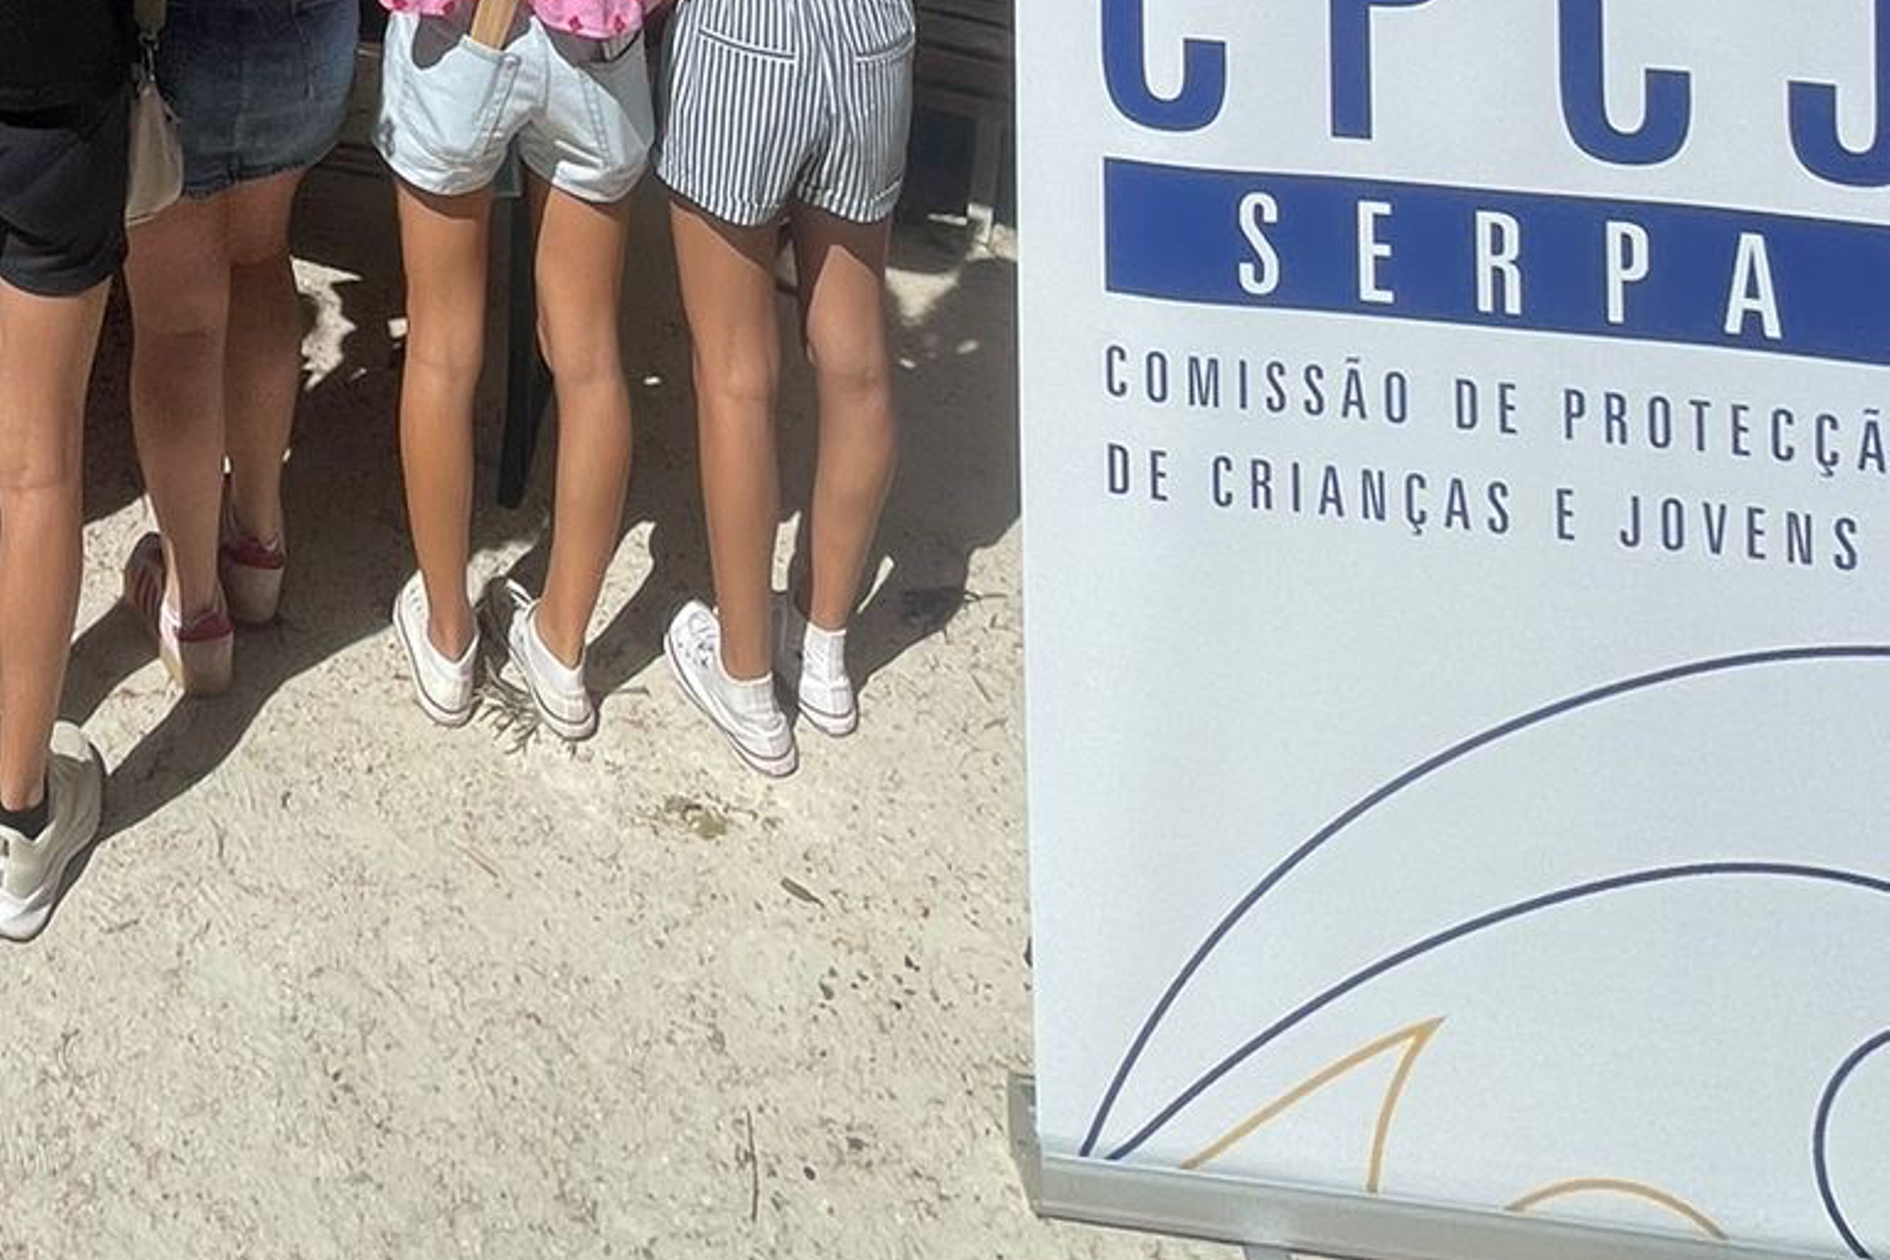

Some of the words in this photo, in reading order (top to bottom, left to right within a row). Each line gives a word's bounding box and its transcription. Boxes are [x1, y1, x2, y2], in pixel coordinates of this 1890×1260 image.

[1238, 192, 1783, 340] SERPA
[1105, 345, 1408, 424] COMISSÃO
[1455, 378, 1517, 435] DE
[1563, 388, 1887, 477] PROTECÇÃ
[1107, 442, 1168, 502] DE
[1212, 455, 1509, 536] CRIANÇAS
[1556, 488, 1575, 541] E
[1620, 496, 1859, 571] JOVENS
